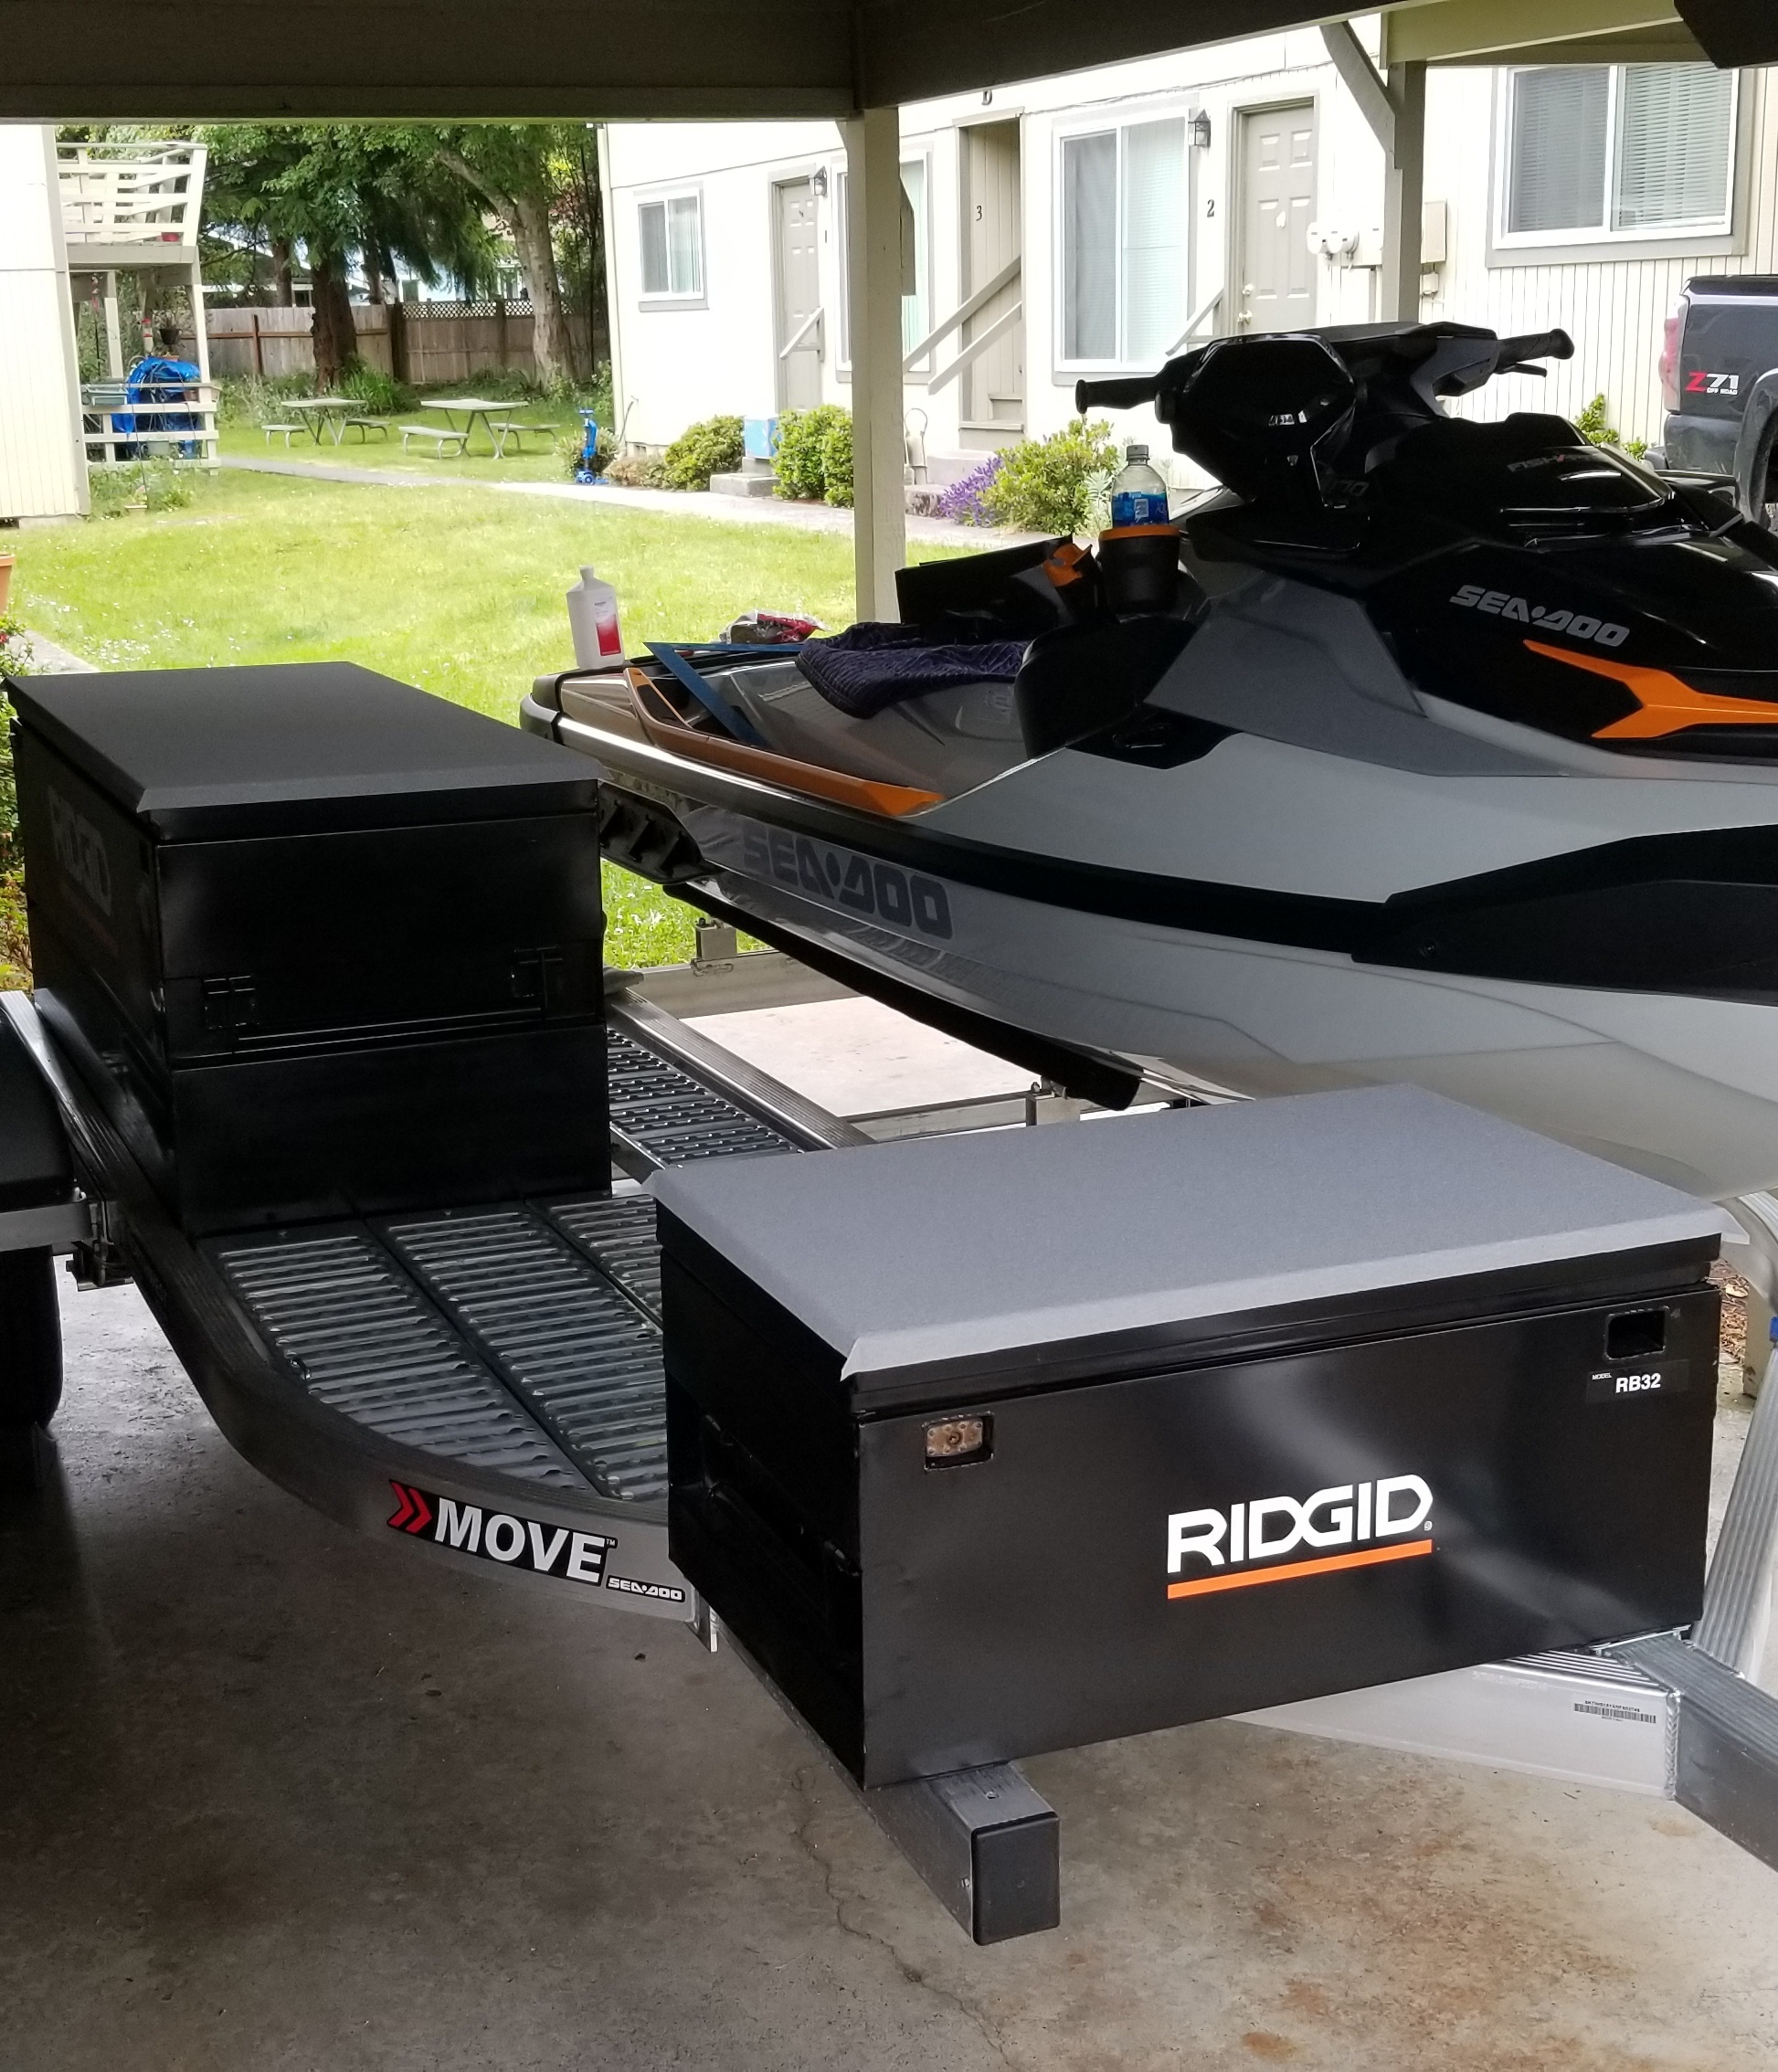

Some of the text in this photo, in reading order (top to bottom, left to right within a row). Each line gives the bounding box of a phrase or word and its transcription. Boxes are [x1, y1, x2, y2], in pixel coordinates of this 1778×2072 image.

[976, 205, 983, 222] 3
[1206, 198, 1215, 218] 2
[1685, 371, 1740, 393] Z71
[1614, 1372, 1662, 1393] RB32
[1167, 1474, 1434, 1574] RIDGID
[434, 1496, 606, 1584] MOVE
